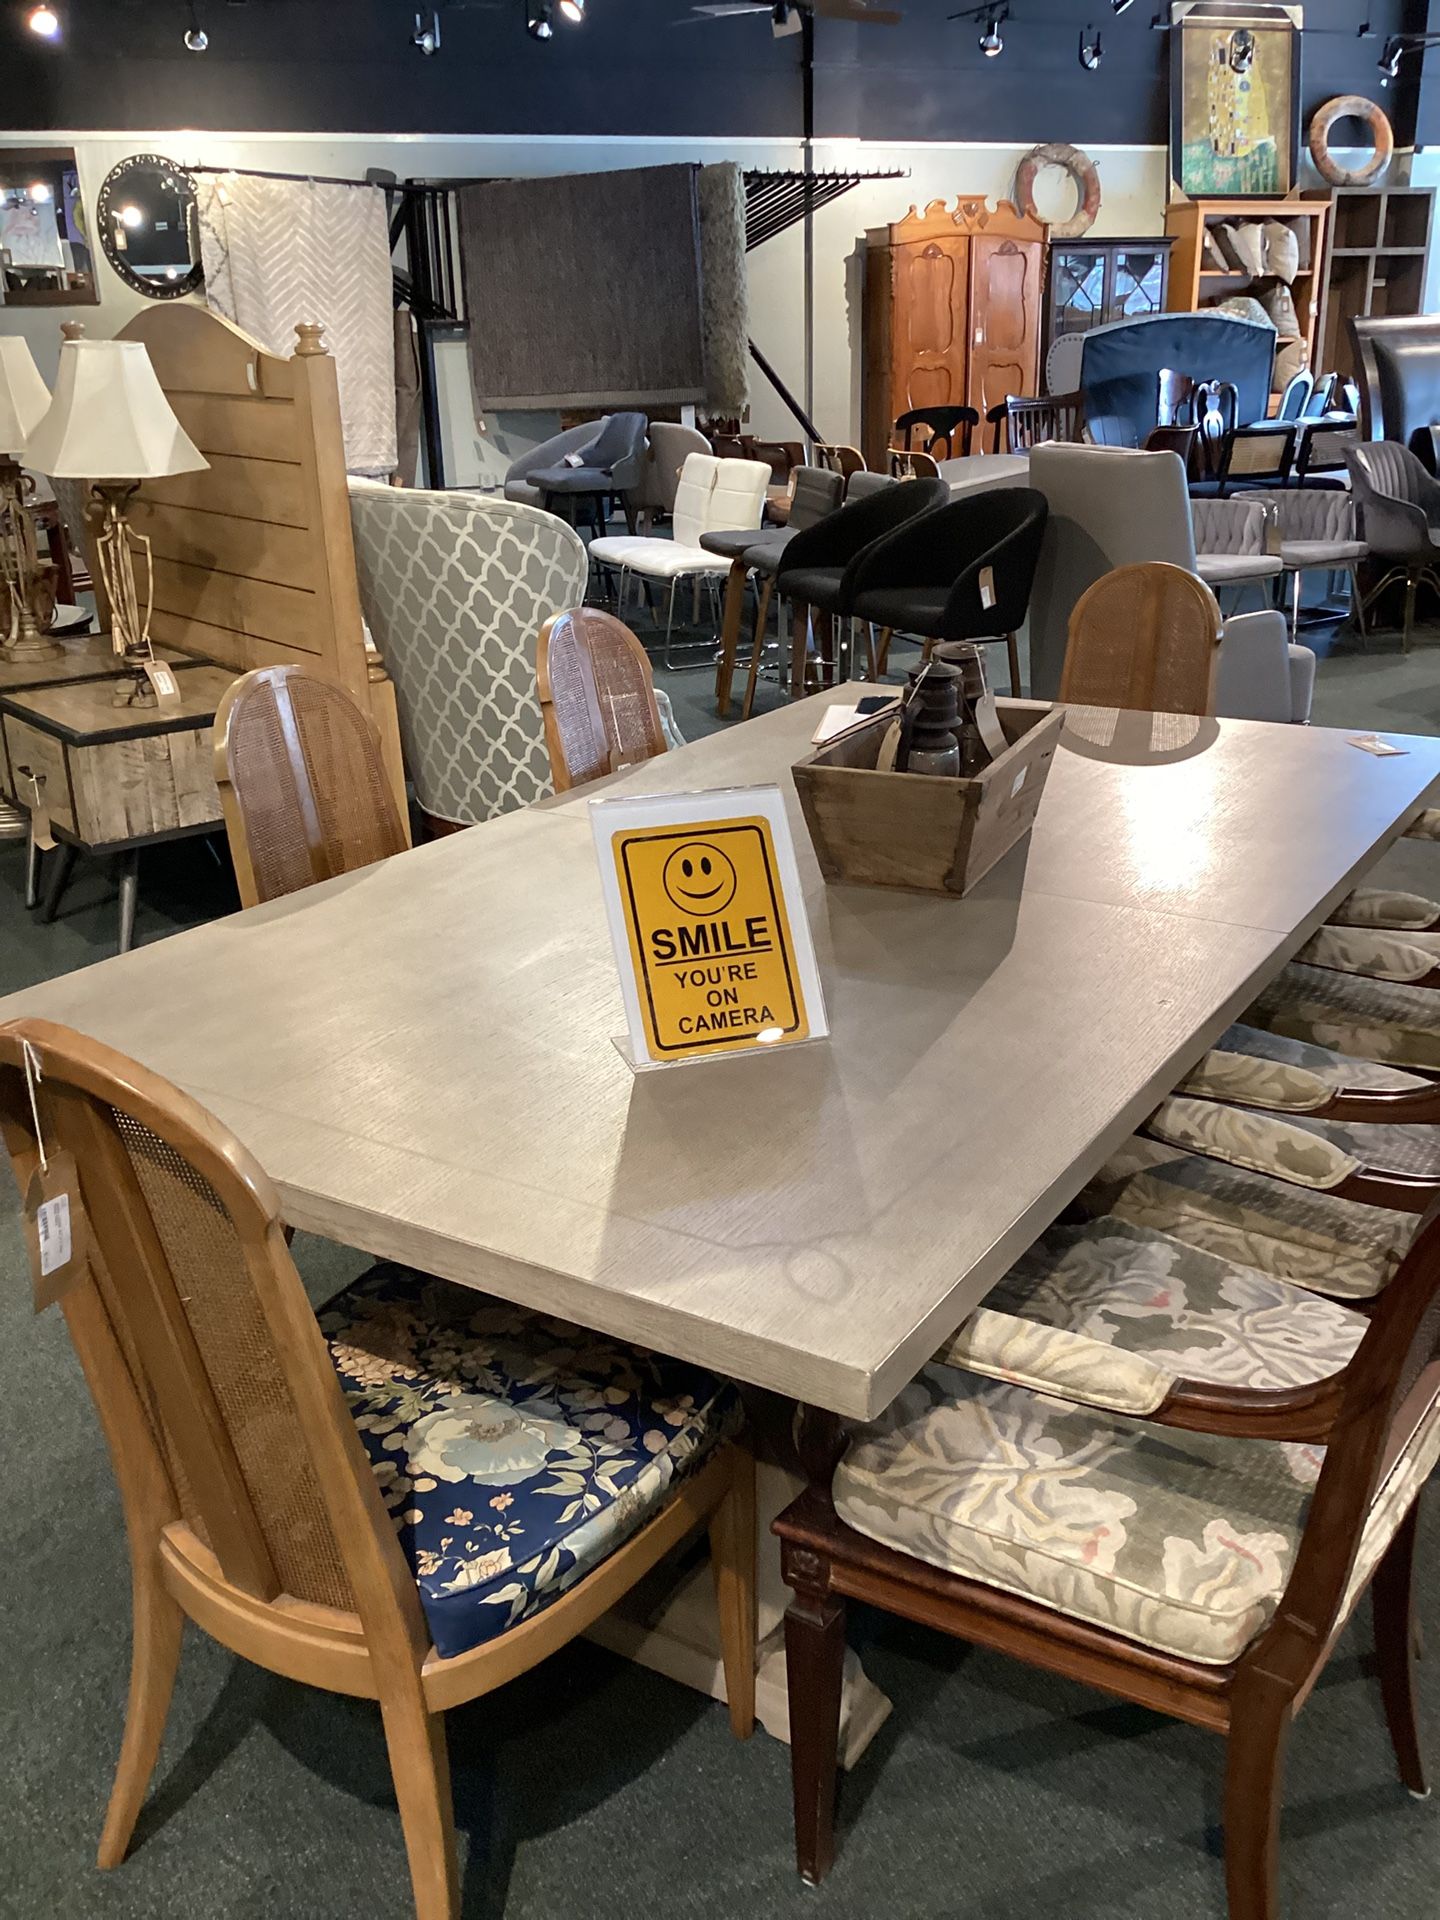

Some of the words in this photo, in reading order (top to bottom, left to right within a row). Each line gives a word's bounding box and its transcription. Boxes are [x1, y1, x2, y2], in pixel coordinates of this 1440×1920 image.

[651, 916, 772, 960] SMILE
[674, 962, 758, 989] YOU'RE
[706, 987, 739, 1007] ON
[678, 1005, 775, 1035] CAMERA
